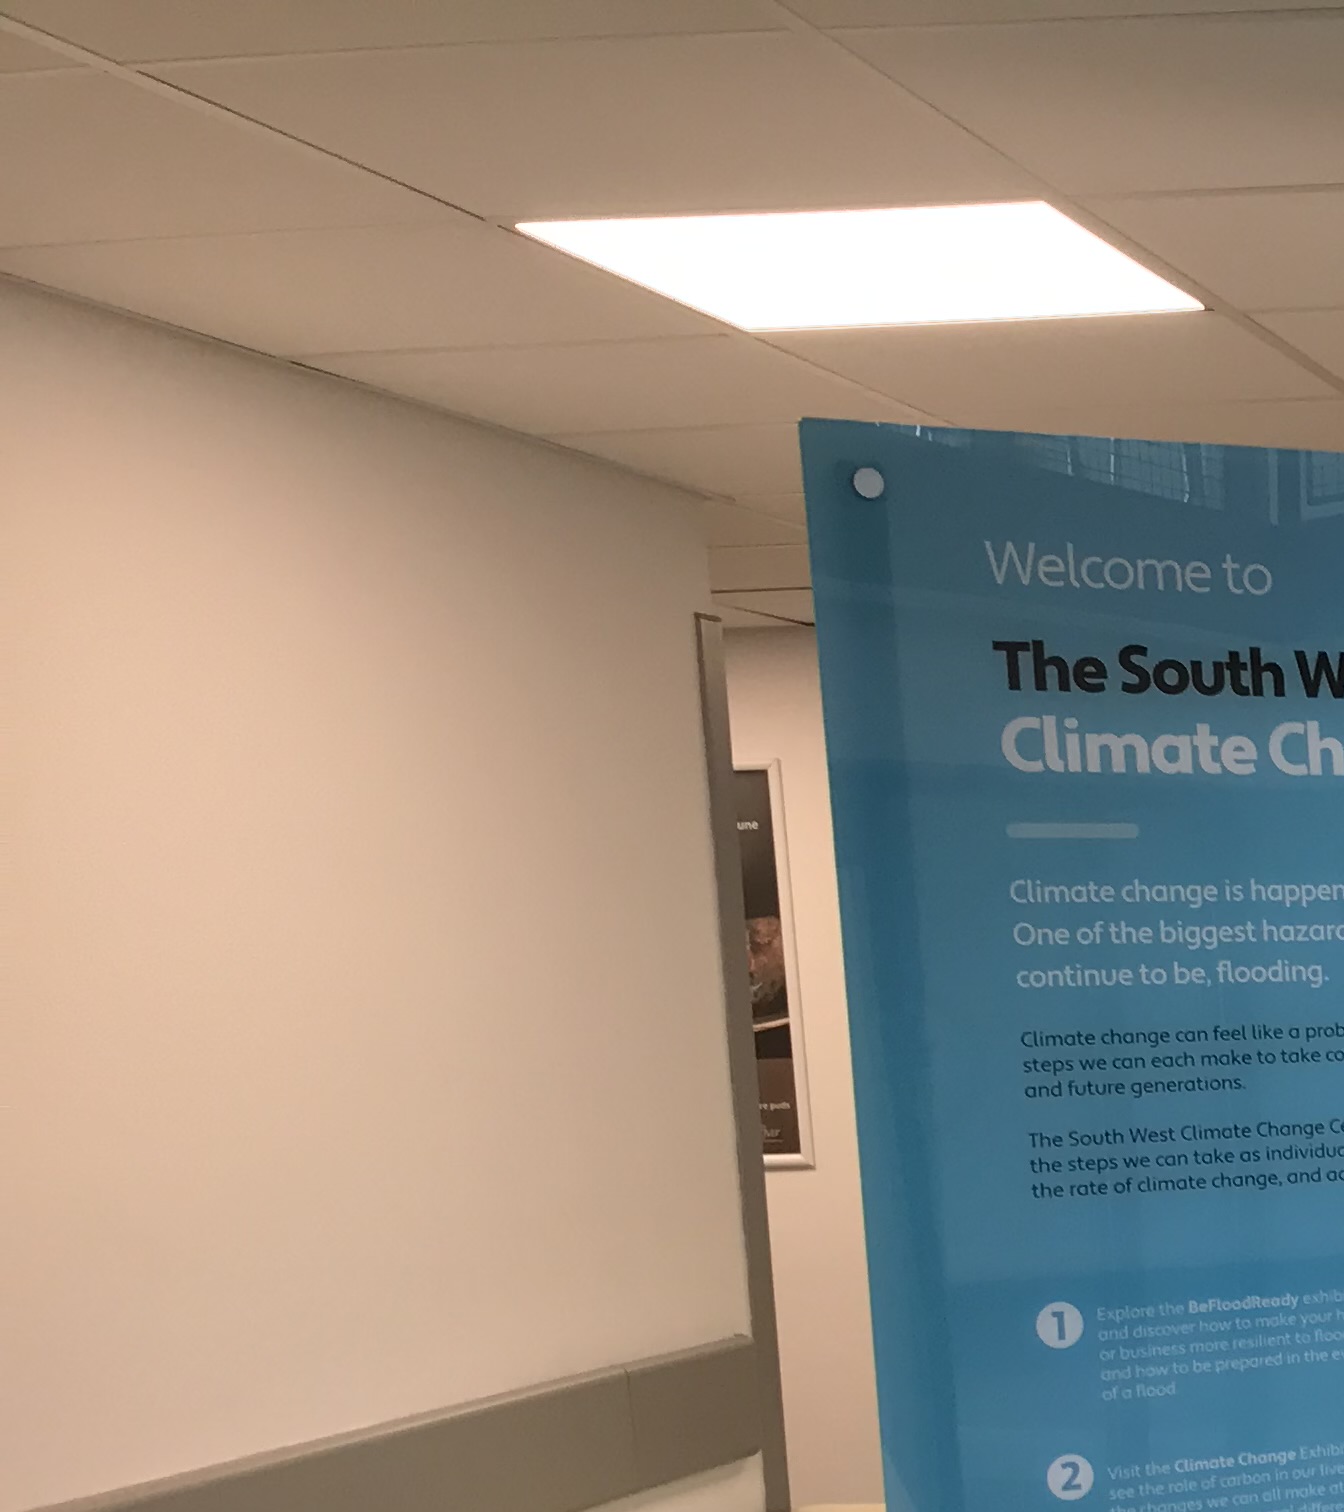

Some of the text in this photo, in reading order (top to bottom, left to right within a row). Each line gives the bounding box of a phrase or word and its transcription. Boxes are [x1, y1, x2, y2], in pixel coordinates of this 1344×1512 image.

[983, 539, 1272, 595] Welcome to
[991, 638, 1108, 693] The
[1117, 643, 1285, 697] South
[1000, 714, 1258, 775] Climate
[1009, 878, 1115, 903] Climate
[1120, 878, 1218, 908] change
[1224, 879, 1244, 901] is
[1012, 921, 1070, 946] One
[1075, 920, 1104, 945] of
[1108, 920, 1153, 944] the
[1159, 919, 1257, 950] biggest
[1015, 958, 1329, 988] continue to be, flooding.
[1020, 1030, 1096, 1048] Climate
[1100, 1027, 1170, 1048] change
[1174, 1029, 1208, 1042] can
[1212, 1024, 1247, 1041] feel
[1251, 1023, 1283, 1040] like
[1288, 1026, 1300, 1039] a
[1022, 1057, 1074, 1076] steps
[1078, 1057, 1107, 1071] we
[1111, 1056, 1146, 1069] can
[1150, 1051, 1195, 1068] each
[1200, 1048, 1252, 1066] make
[1255, 1049, 1276, 1064] to
[1279, 1046, 1321, 1063] take
[1024, 1076, 1246, 1098] and future generations.
[1028, 1131, 1063, 1148] The
[1068, 1128, 1124, 1147] South
[1128, 1127, 1176, 1143] West
[1180, 1123, 1252, 1141] Climate
[1256, 1120, 1324, 1139] Change
[1029, 1156, 1062, 1174] the
[1067, 1155, 1118, 1174] steps
[1122, 1155, 1150, 1168] we
[1154, 1153, 1188, 1167] can
[1192, 1147, 1235, 1165] take
[1238, 1149, 1260, 1163] as
[1030, 1181, 1064, 1199] the
[1069, 1180, 1108, 1196] rate
[1112, 1176, 1133, 1194] of
[1136, 1174, 1206, 1193] climate
[1210, 1171, 1282, 1190] change,
[1286, 1166, 1321, 1184] and
[1051, 1311, 1068, 1341] 1
[1060, 1461, 1082, 1492] 2
